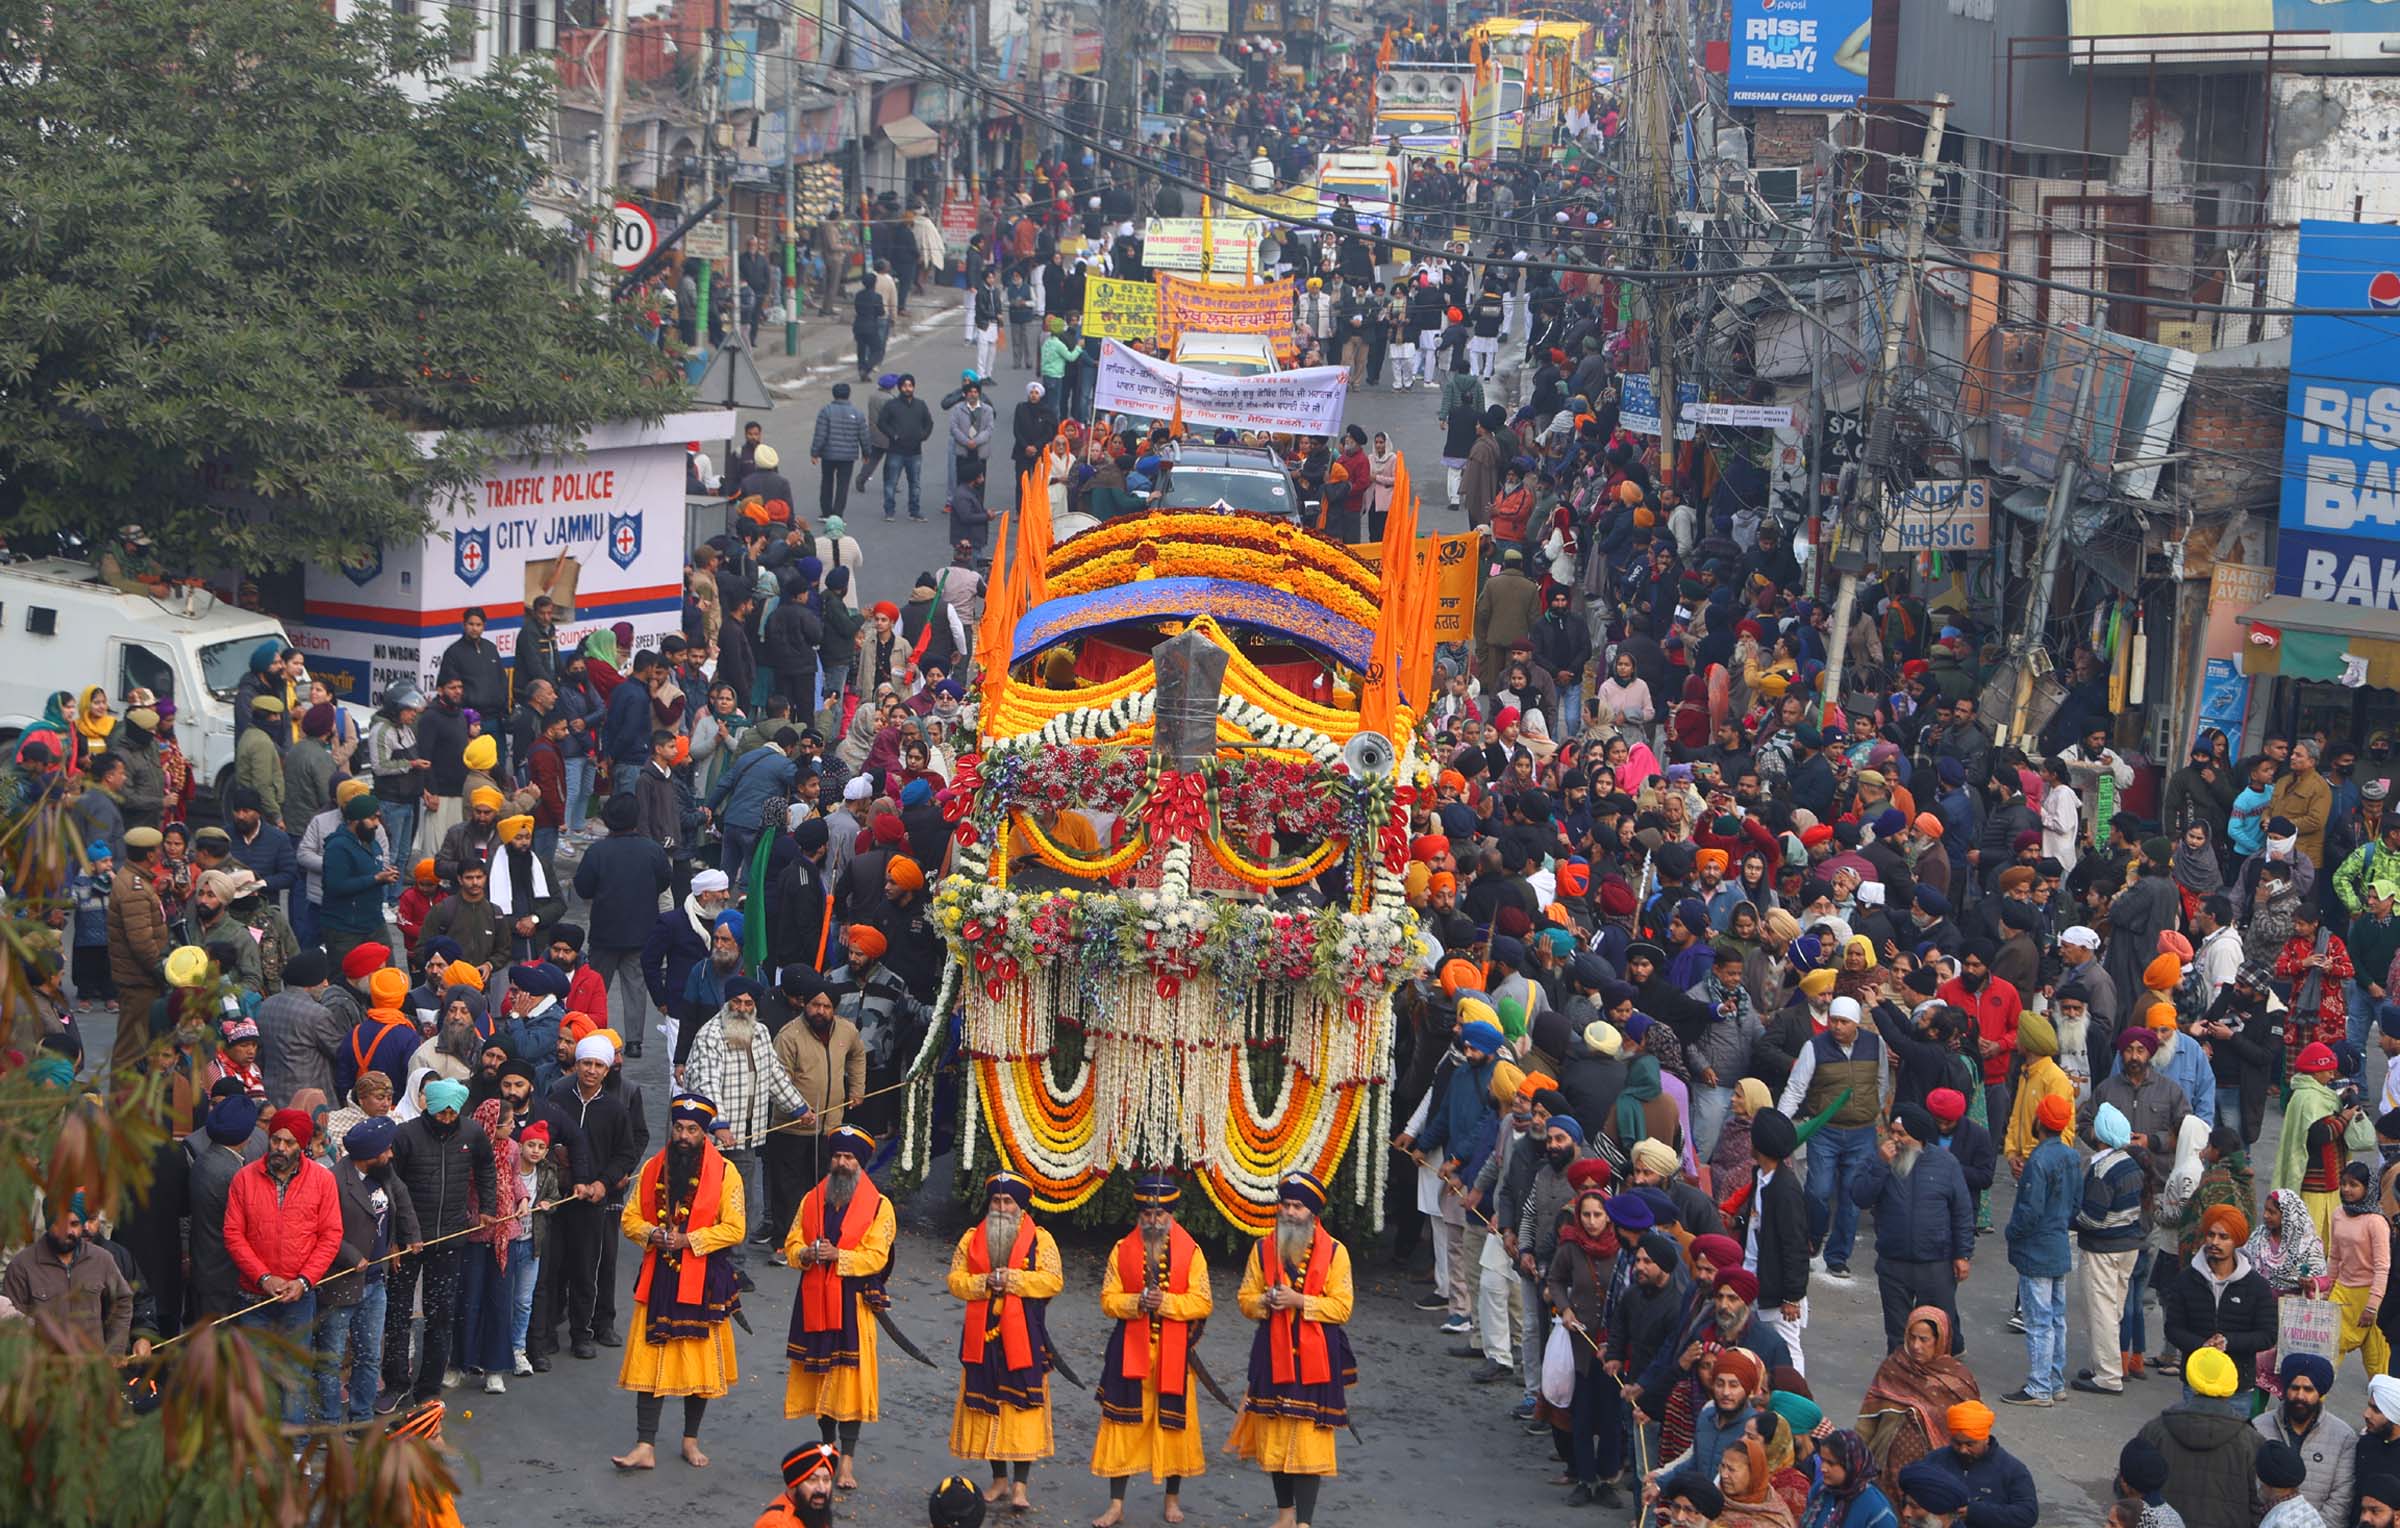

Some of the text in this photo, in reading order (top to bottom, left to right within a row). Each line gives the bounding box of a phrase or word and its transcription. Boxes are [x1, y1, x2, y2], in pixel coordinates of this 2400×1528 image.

[1776, 0, 1807, 10] pepsi
[1746, 18, 1818, 42] RISE
[1768, 36, 1799, 53] UP
[1746, 45, 1817, 73] BABY!
[1733, 91, 1854, 103] KRISHAN CHAND GUPTA
[2301, 386, 2400, 451] RIS
[486, 471, 614, 508] TRAFFIC POLICE
[496, 519, 537, 549] CITY
[544, 512, 604, 545] JAMMU
[1899, 523, 1975, 547] MUSIC
[2300, 549, 2400, 611] BAK
[635, 633, 655, 648] SPEED
[374, 644, 420, 662] NO WRONG
